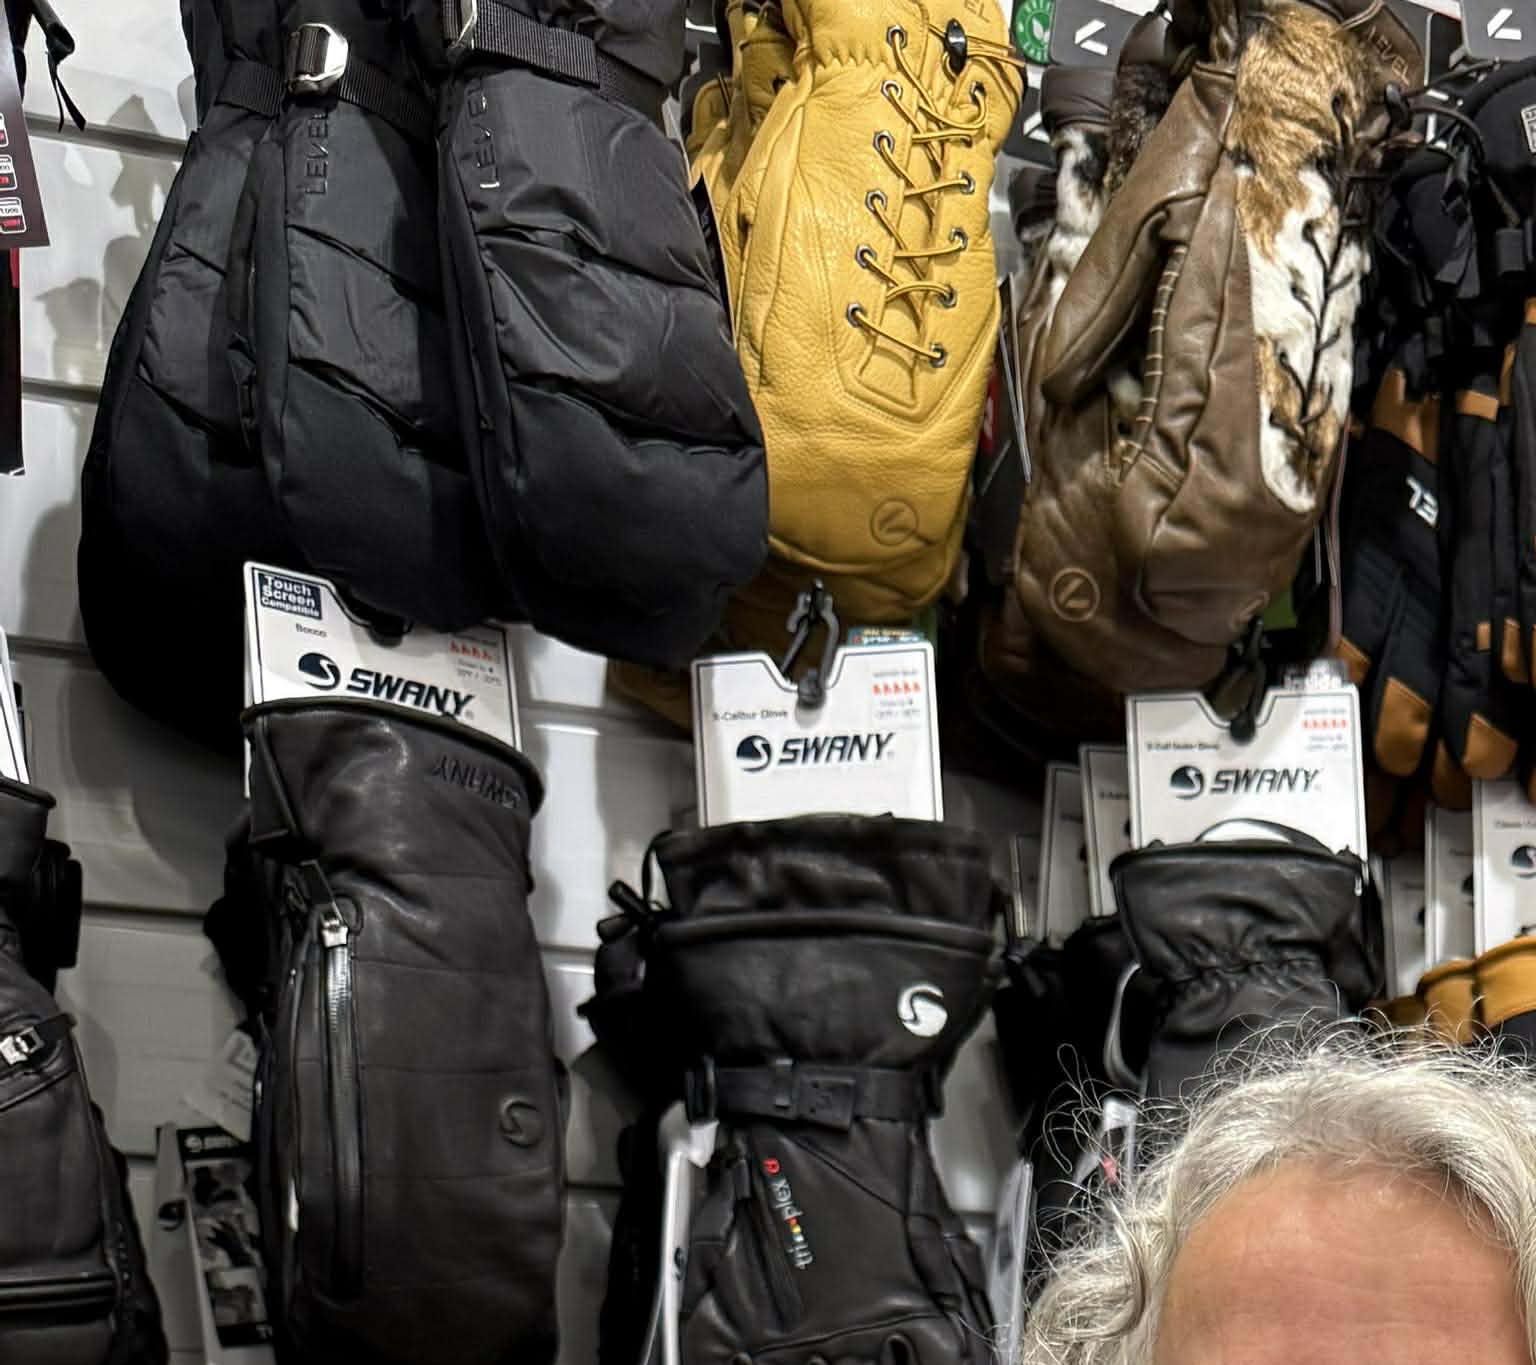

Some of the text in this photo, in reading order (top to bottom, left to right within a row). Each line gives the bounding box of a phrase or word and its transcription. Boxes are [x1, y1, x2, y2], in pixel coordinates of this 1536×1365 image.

[304, 112, 329, 195] LEVEL
[262, 585, 316, 608] Screen
[264, 575, 313, 597] Touch
[261, 597, 321, 618] Compatible
[346, 667, 475, 716] SWANY
[778, 732, 894, 766] SWANY
[1209, 767, 1320, 795] SWANY
